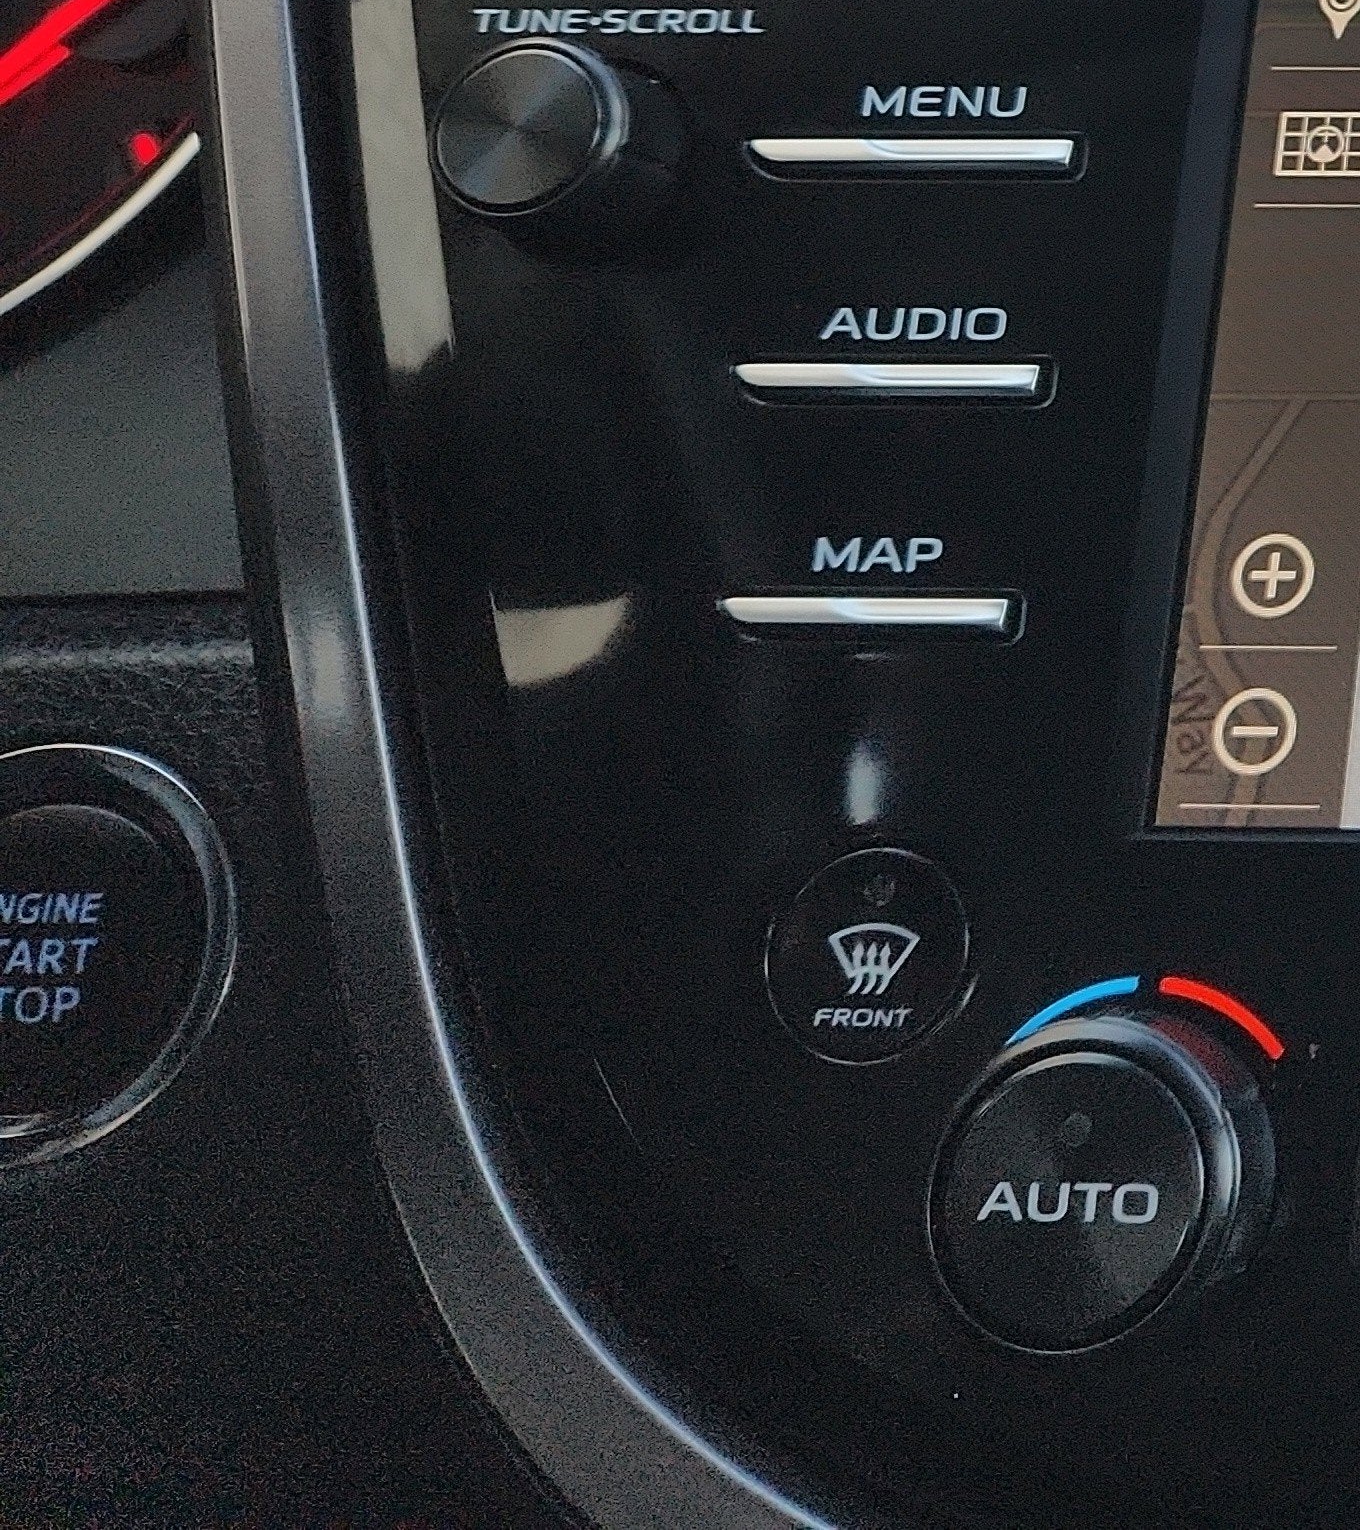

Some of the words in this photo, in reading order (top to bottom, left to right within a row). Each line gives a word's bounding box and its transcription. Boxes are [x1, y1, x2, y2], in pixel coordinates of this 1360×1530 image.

[860, 84, 1028, 119] MENU
[819, 306, 1009, 342] AUDIO
[811, 535, 944, 574] MAP
[0, 938, 99, 975] ART
[812, 1006, 913, 1028] FRONT
[976, 1180, 1161, 1225] AUTO
